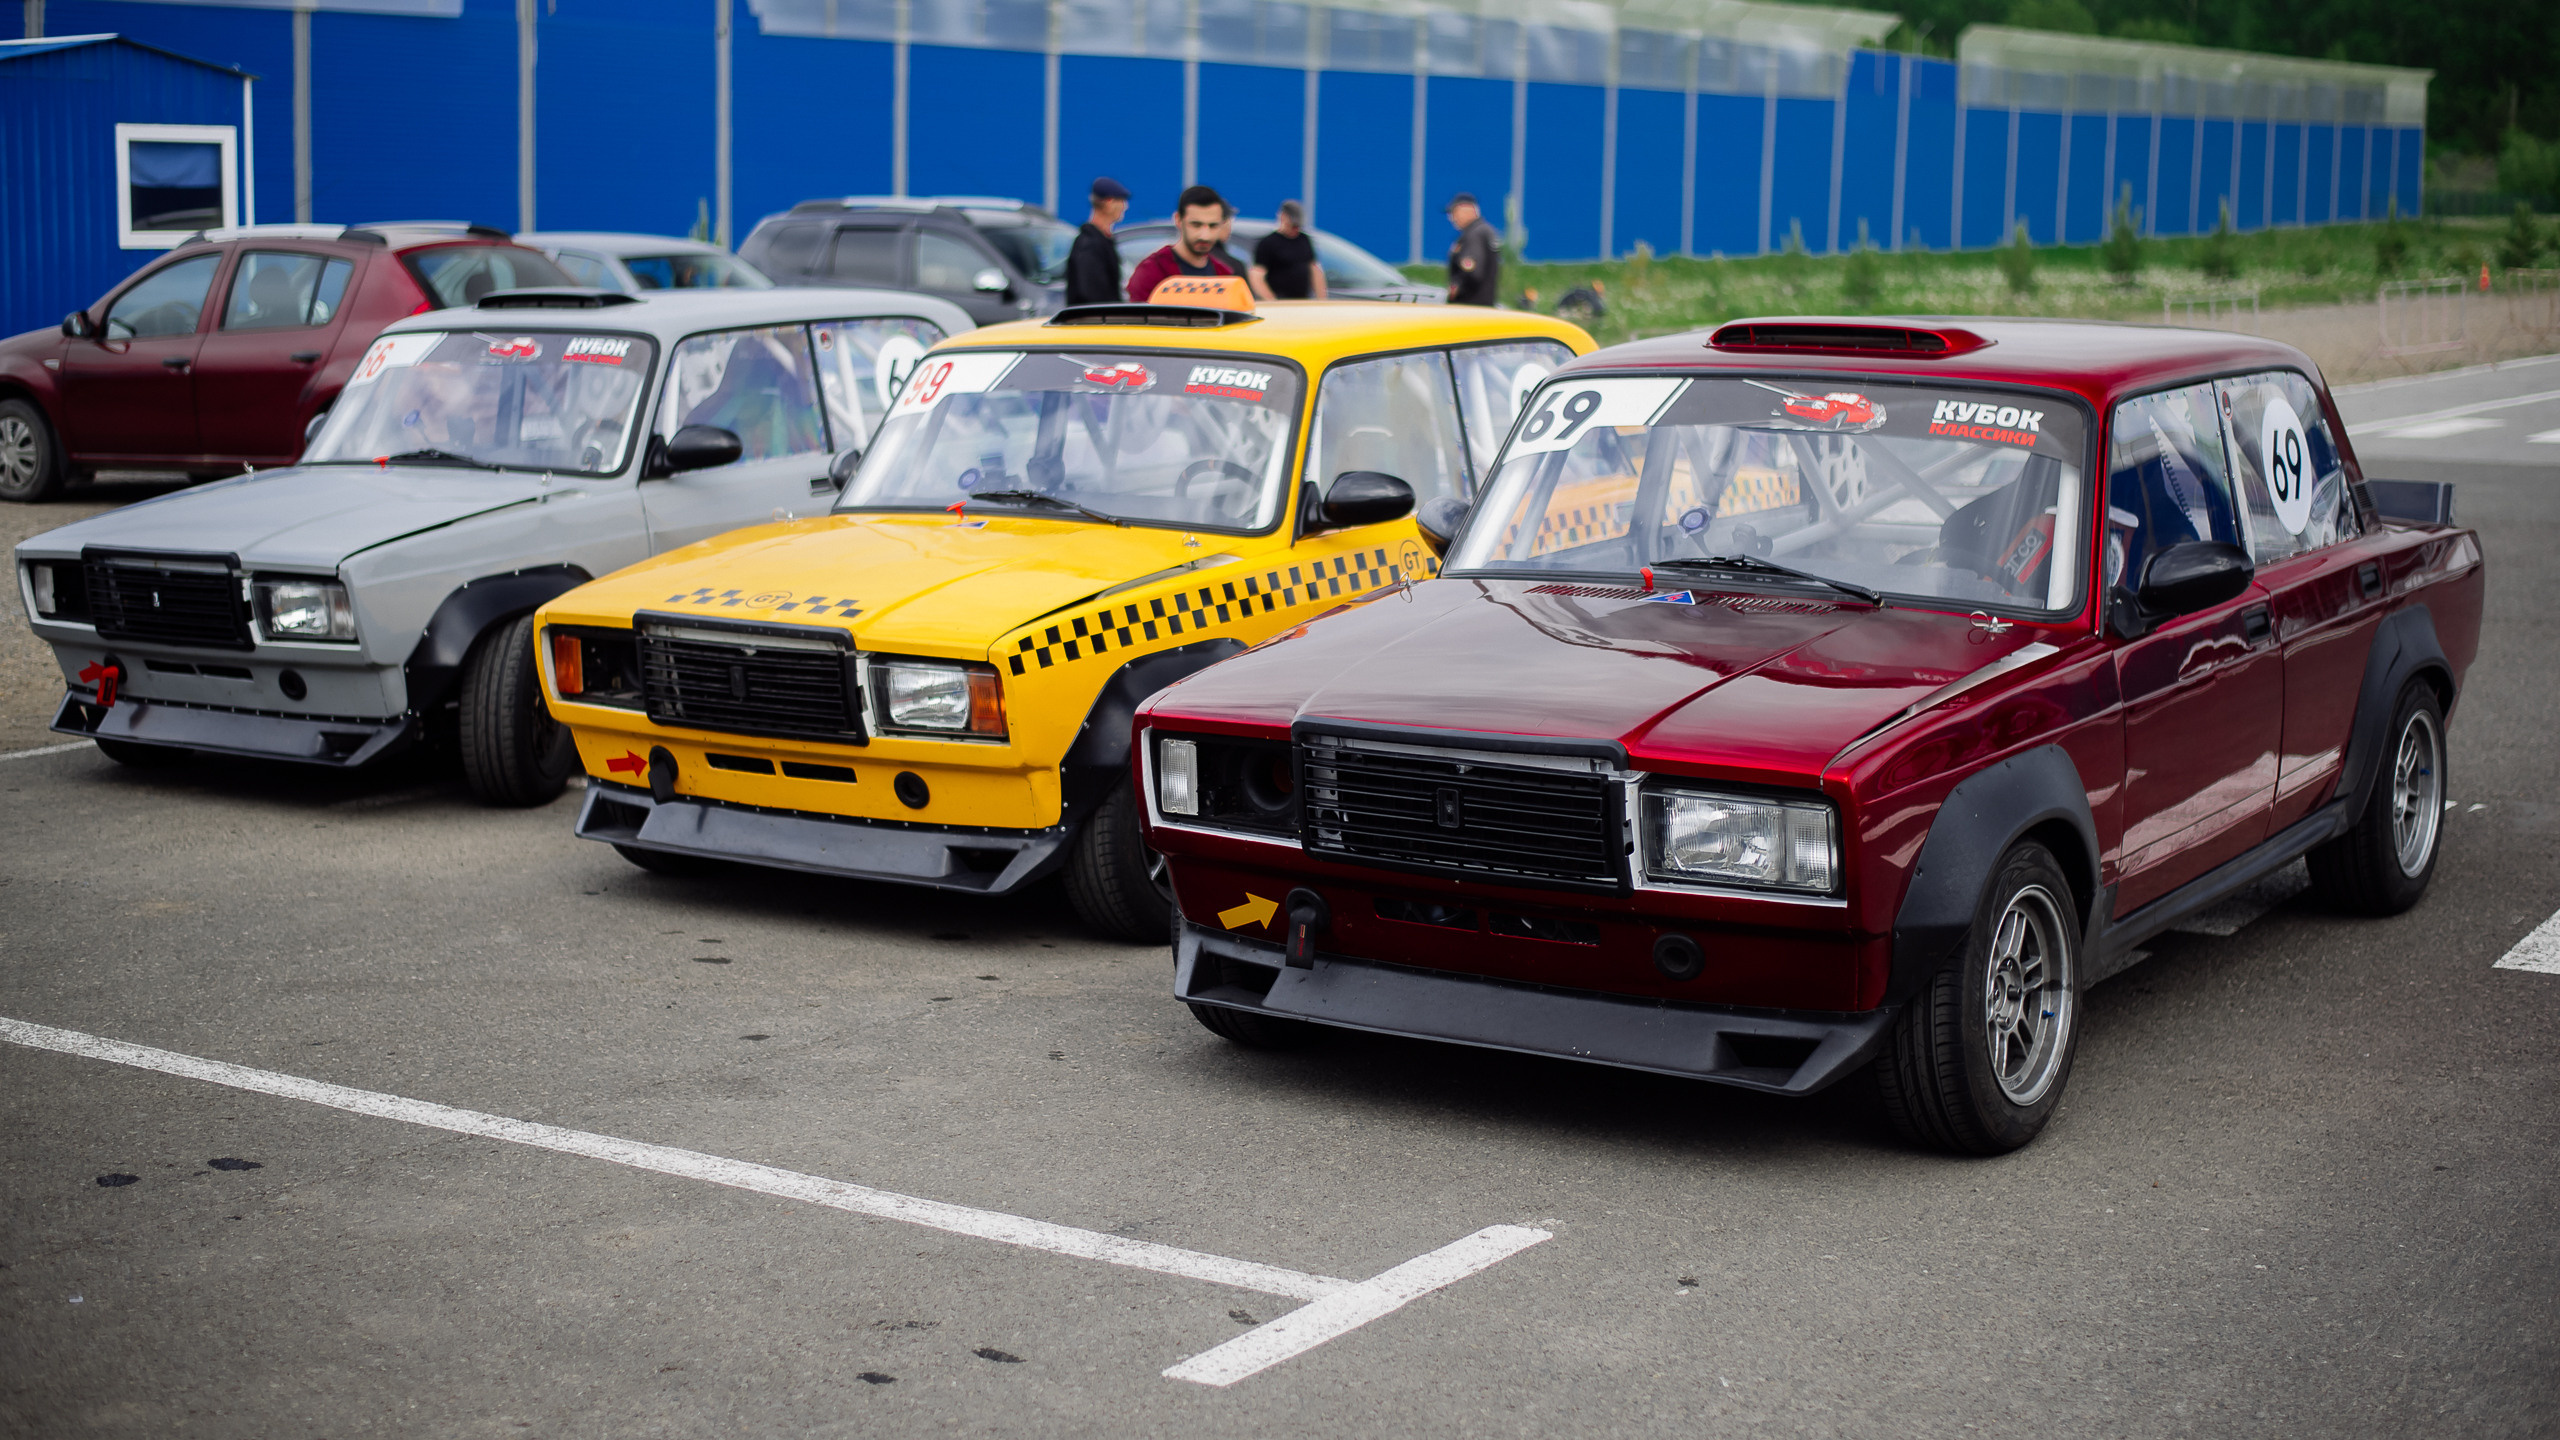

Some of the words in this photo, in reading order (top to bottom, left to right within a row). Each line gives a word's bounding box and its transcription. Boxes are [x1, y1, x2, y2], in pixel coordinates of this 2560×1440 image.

[565, 337, 632, 357] КУБОК
[904, 362, 954, 406] 99
[1187, 365, 1272, 391] КУБОК
[1184, 384, 1264, 402] КЛАССИКИ
[1521, 390, 1602, 442] 69
[1933, 399, 2045, 432] КУБОК
[1928, 422, 2037, 447] КЛАССИКИ
[2272, 428, 2302, 503] 69
[1404, 551, 1420, 570] GT
[754, 594, 787, 604] GT
